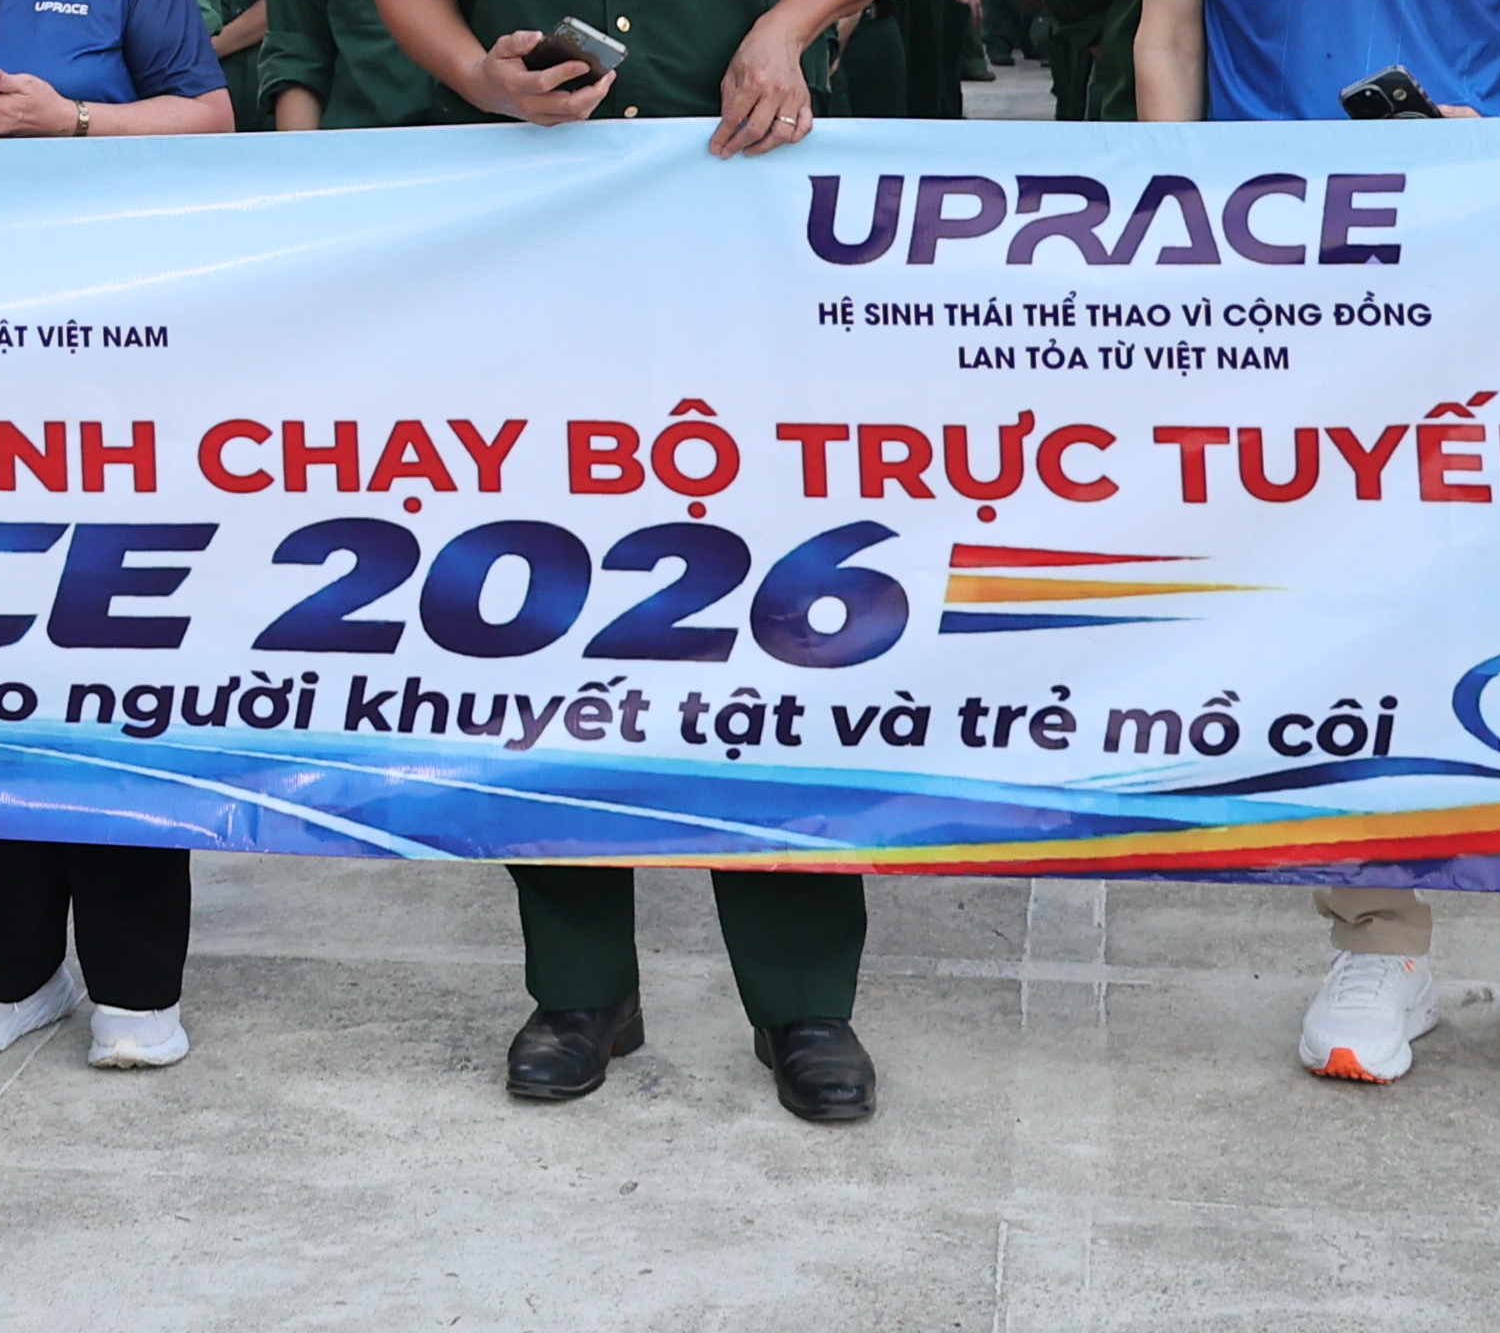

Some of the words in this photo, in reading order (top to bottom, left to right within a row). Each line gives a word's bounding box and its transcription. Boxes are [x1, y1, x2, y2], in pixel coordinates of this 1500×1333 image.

[35, 1, 89, 16] UPRACE
[807, 173, 1406, 265] UPRACE
[37, 319, 92, 354] VIỆT
[103, 326, 168, 347] NAM
[819, 296, 854, 332] HỆ
[865, 303, 933, 326] SINH
[944, 297, 1012, 326] THÁI
[1023, 291, 1076, 326] THỂ
[1086, 304, 1171, 327] THAO
[1182, 297, 1211, 326] VÌ
[1223, 297, 1322, 333] CỘNG
[1333, 291, 1431, 327] ĐỒNG
[959, 347, 1015, 369] LAN
[1025, 338, 1088, 369] TỎA
[1098, 340, 1135, 369] TỪ
[1144, 340, 1206, 376] VIỆT
[1217, 347, 1288, 369] NAM
[199, 419, 526, 513] CHẠY
[568, 399, 740, 519] BỘ
[778, 411, 1118, 522] TRỰC
[251, 518, 909, 668] 2026
[65, 670, 315, 738] người
[346, 675, 649, 751] khuyết
[679, 687, 805, 761] tật
[831, 690, 930, 748] và
[958, 685, 1078, 751] trẻ
[1104, 690, 1242, 758] mồ
[1268, 694, 1400, 759] côi
